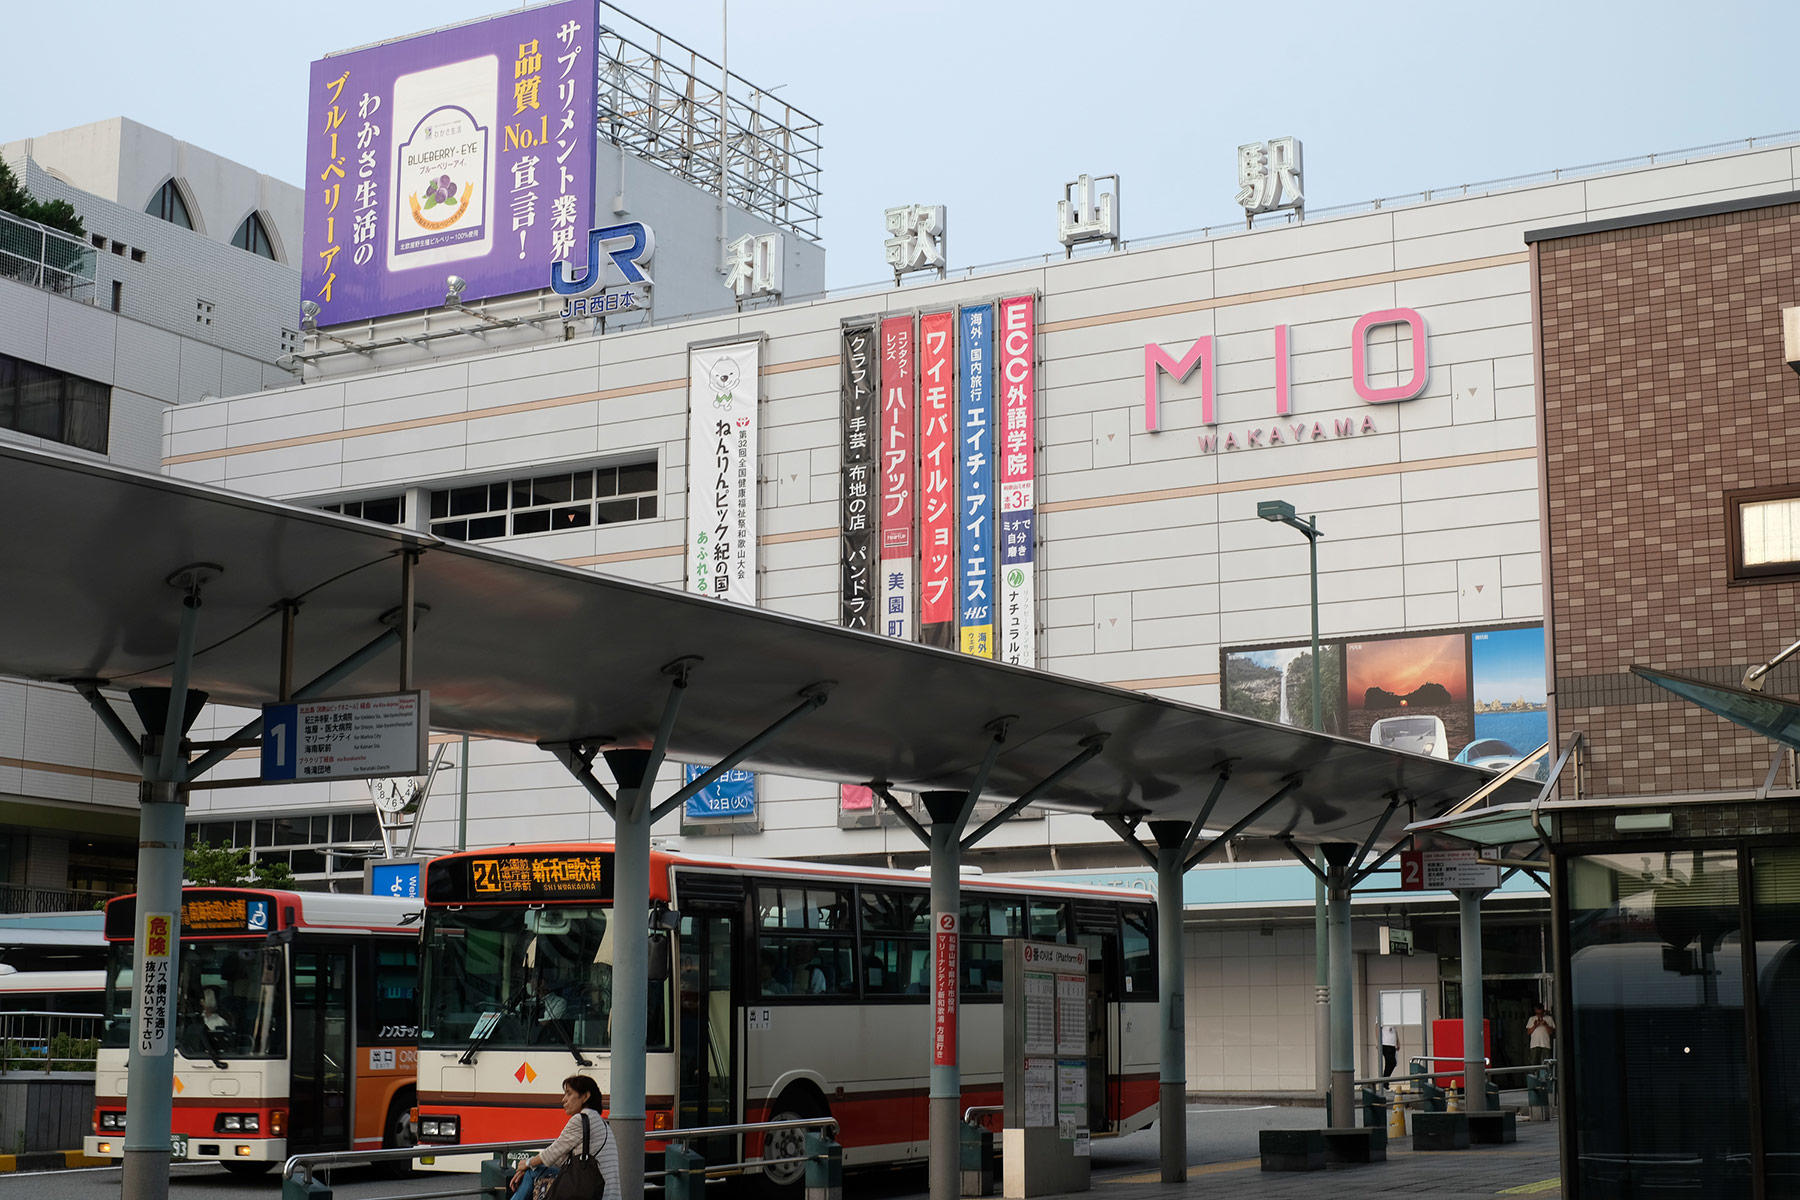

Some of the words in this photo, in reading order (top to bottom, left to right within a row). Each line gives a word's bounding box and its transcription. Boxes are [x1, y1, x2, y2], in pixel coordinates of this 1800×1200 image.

[419, 159, 465, 175] ブルーベリーアイ
[549, 20, 581, 262] サプリメント業界
[317, 71, 350, 302] ブルーベリーアイ
[353, 93, 381, 265] わかさ生活の
[551, 221, 655, 296] JR
[560, 290, 635, 318] JR西日本
[887, 333, 897, 361] レンズ
[898, 331, 908, 379] コンタクト
[970, 313, 983, 403] 海外・国内旅行
[1144, 307, 1430, 433] MIO
[1005, 304, 1029, 477] ECC外語学院
[849, 336, 867, 531] クラフト・手芸・布地の店
[885, 387, 909, 517] ハートアップ
[926, 331, 950, 605] ワイモバイルショップ
[1197, 415, 1377, 452] WAKAYAMA
[713, 419, 732, 600] ねんりんピック紀の国
[736, 430, 748, 580] 第32回全国健康福祉祭和歌山大会
[966, 407, 987, 601] エイチ・アイ・エス
[1003, 519, 1031, 531] ミオで
[1012, 490, 1030, 509] 3F
[1007, 532, 1027, 544] 自分
[849, 545, 867, 628] パンドラハ
[888, 572, 905, 638] 美園町
[270, 723, 287, 767] 1
[305, 733, 352, 743] マリーナシティ
[391, 875, 403, 897] よ
[474, 861, 501, 891] 24
[532, 857, 601, 882] 新和歌浦
[1405, 861, 1420, 883] 2
[148, 917, 167, 955] 危険
[142, 960, 156, 1050] 抜けないで下さい
[155, 961, 168, 1040] バス構内を通り
